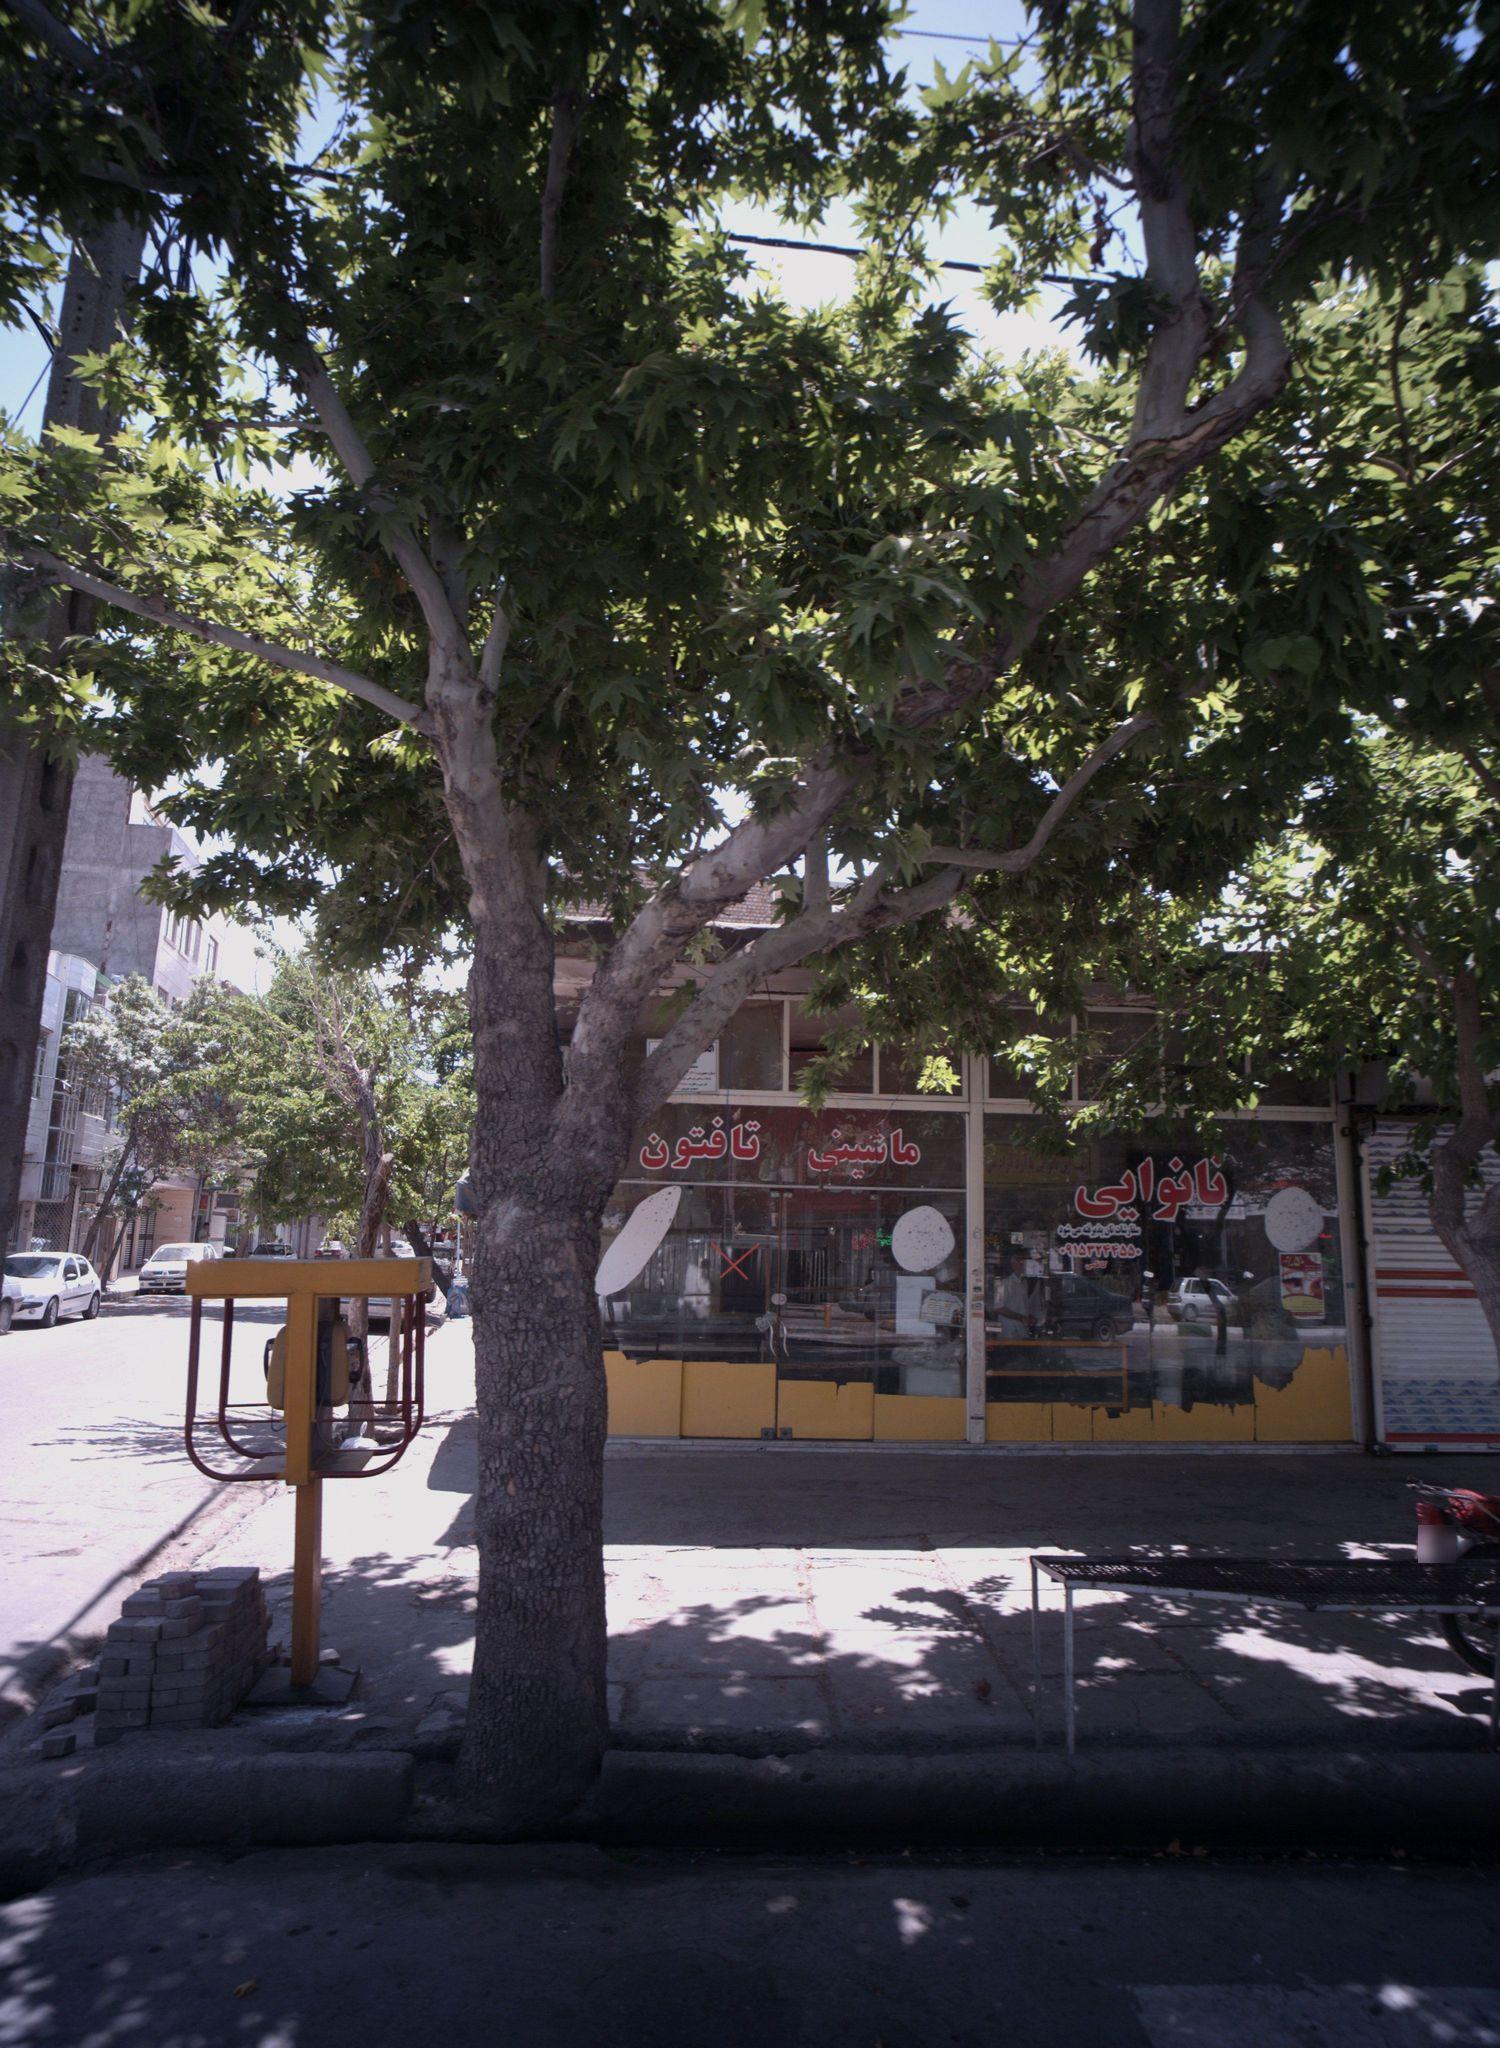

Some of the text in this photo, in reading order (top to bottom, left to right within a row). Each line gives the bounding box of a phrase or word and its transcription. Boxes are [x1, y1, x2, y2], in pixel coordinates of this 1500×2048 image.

[640, 1116, 921, 1179] ماشینی تافتون
[1075, 1155, 1227, 1222] نانوایی
